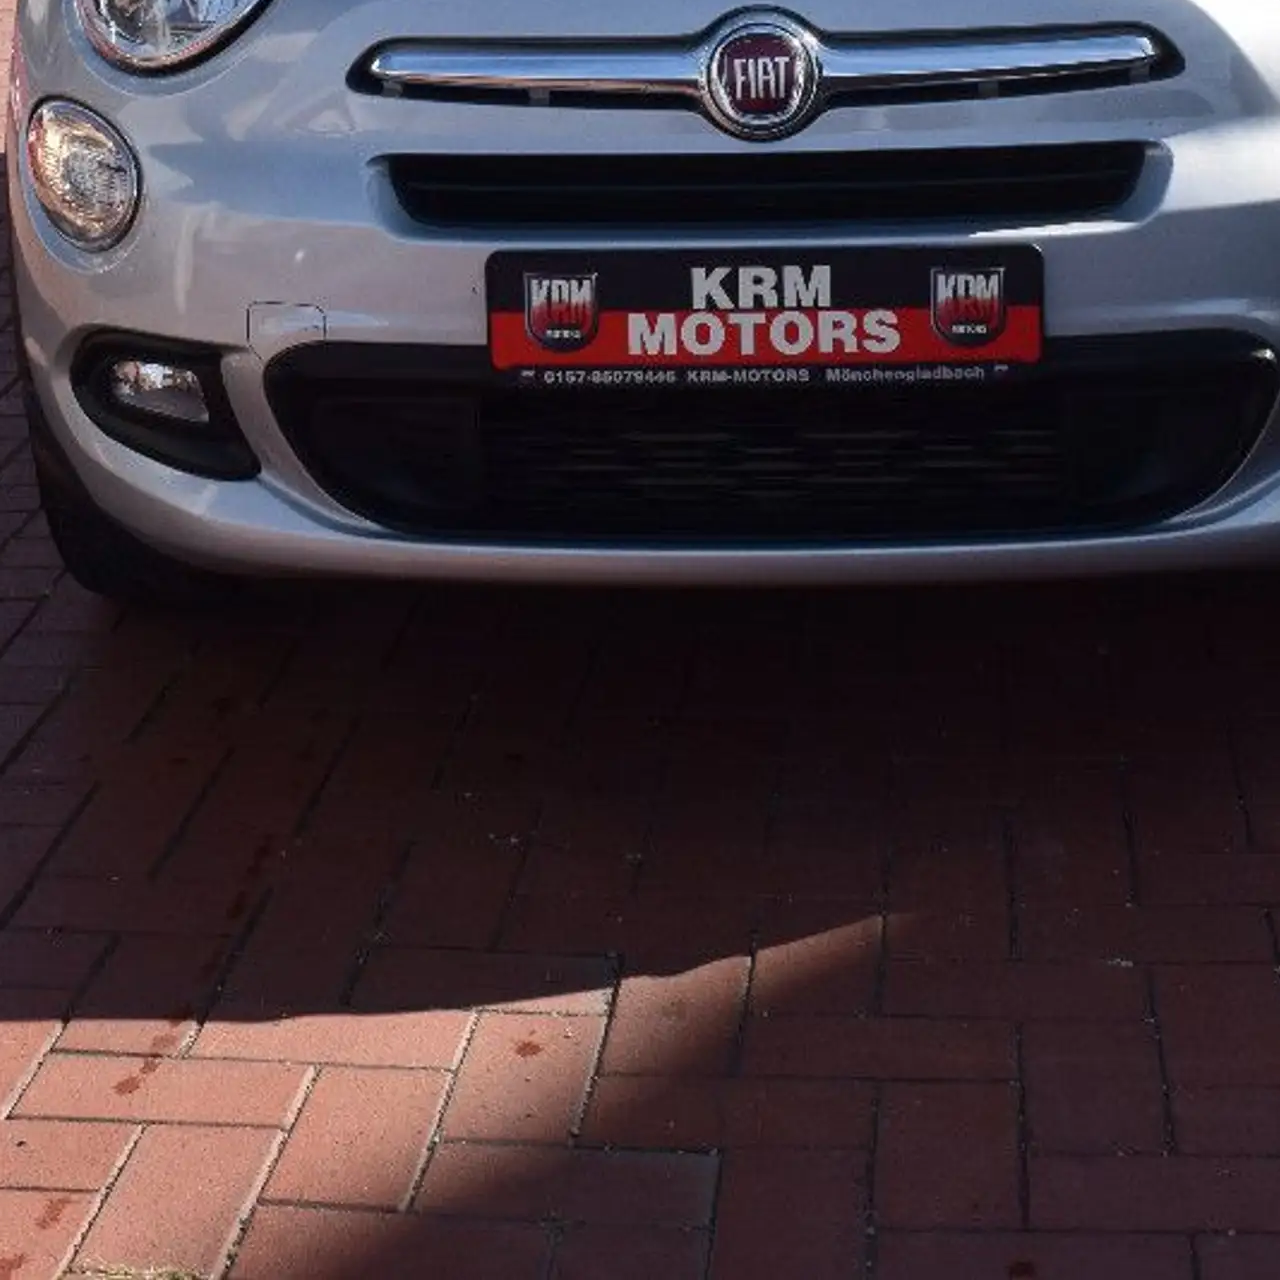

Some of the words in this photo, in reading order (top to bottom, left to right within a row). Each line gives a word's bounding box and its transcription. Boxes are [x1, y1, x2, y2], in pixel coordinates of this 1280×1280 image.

[733, 56, 790, 100] FIAT
[690, 265, 831, 310] KRM
[627, 308, 901, 356] MOTORS
